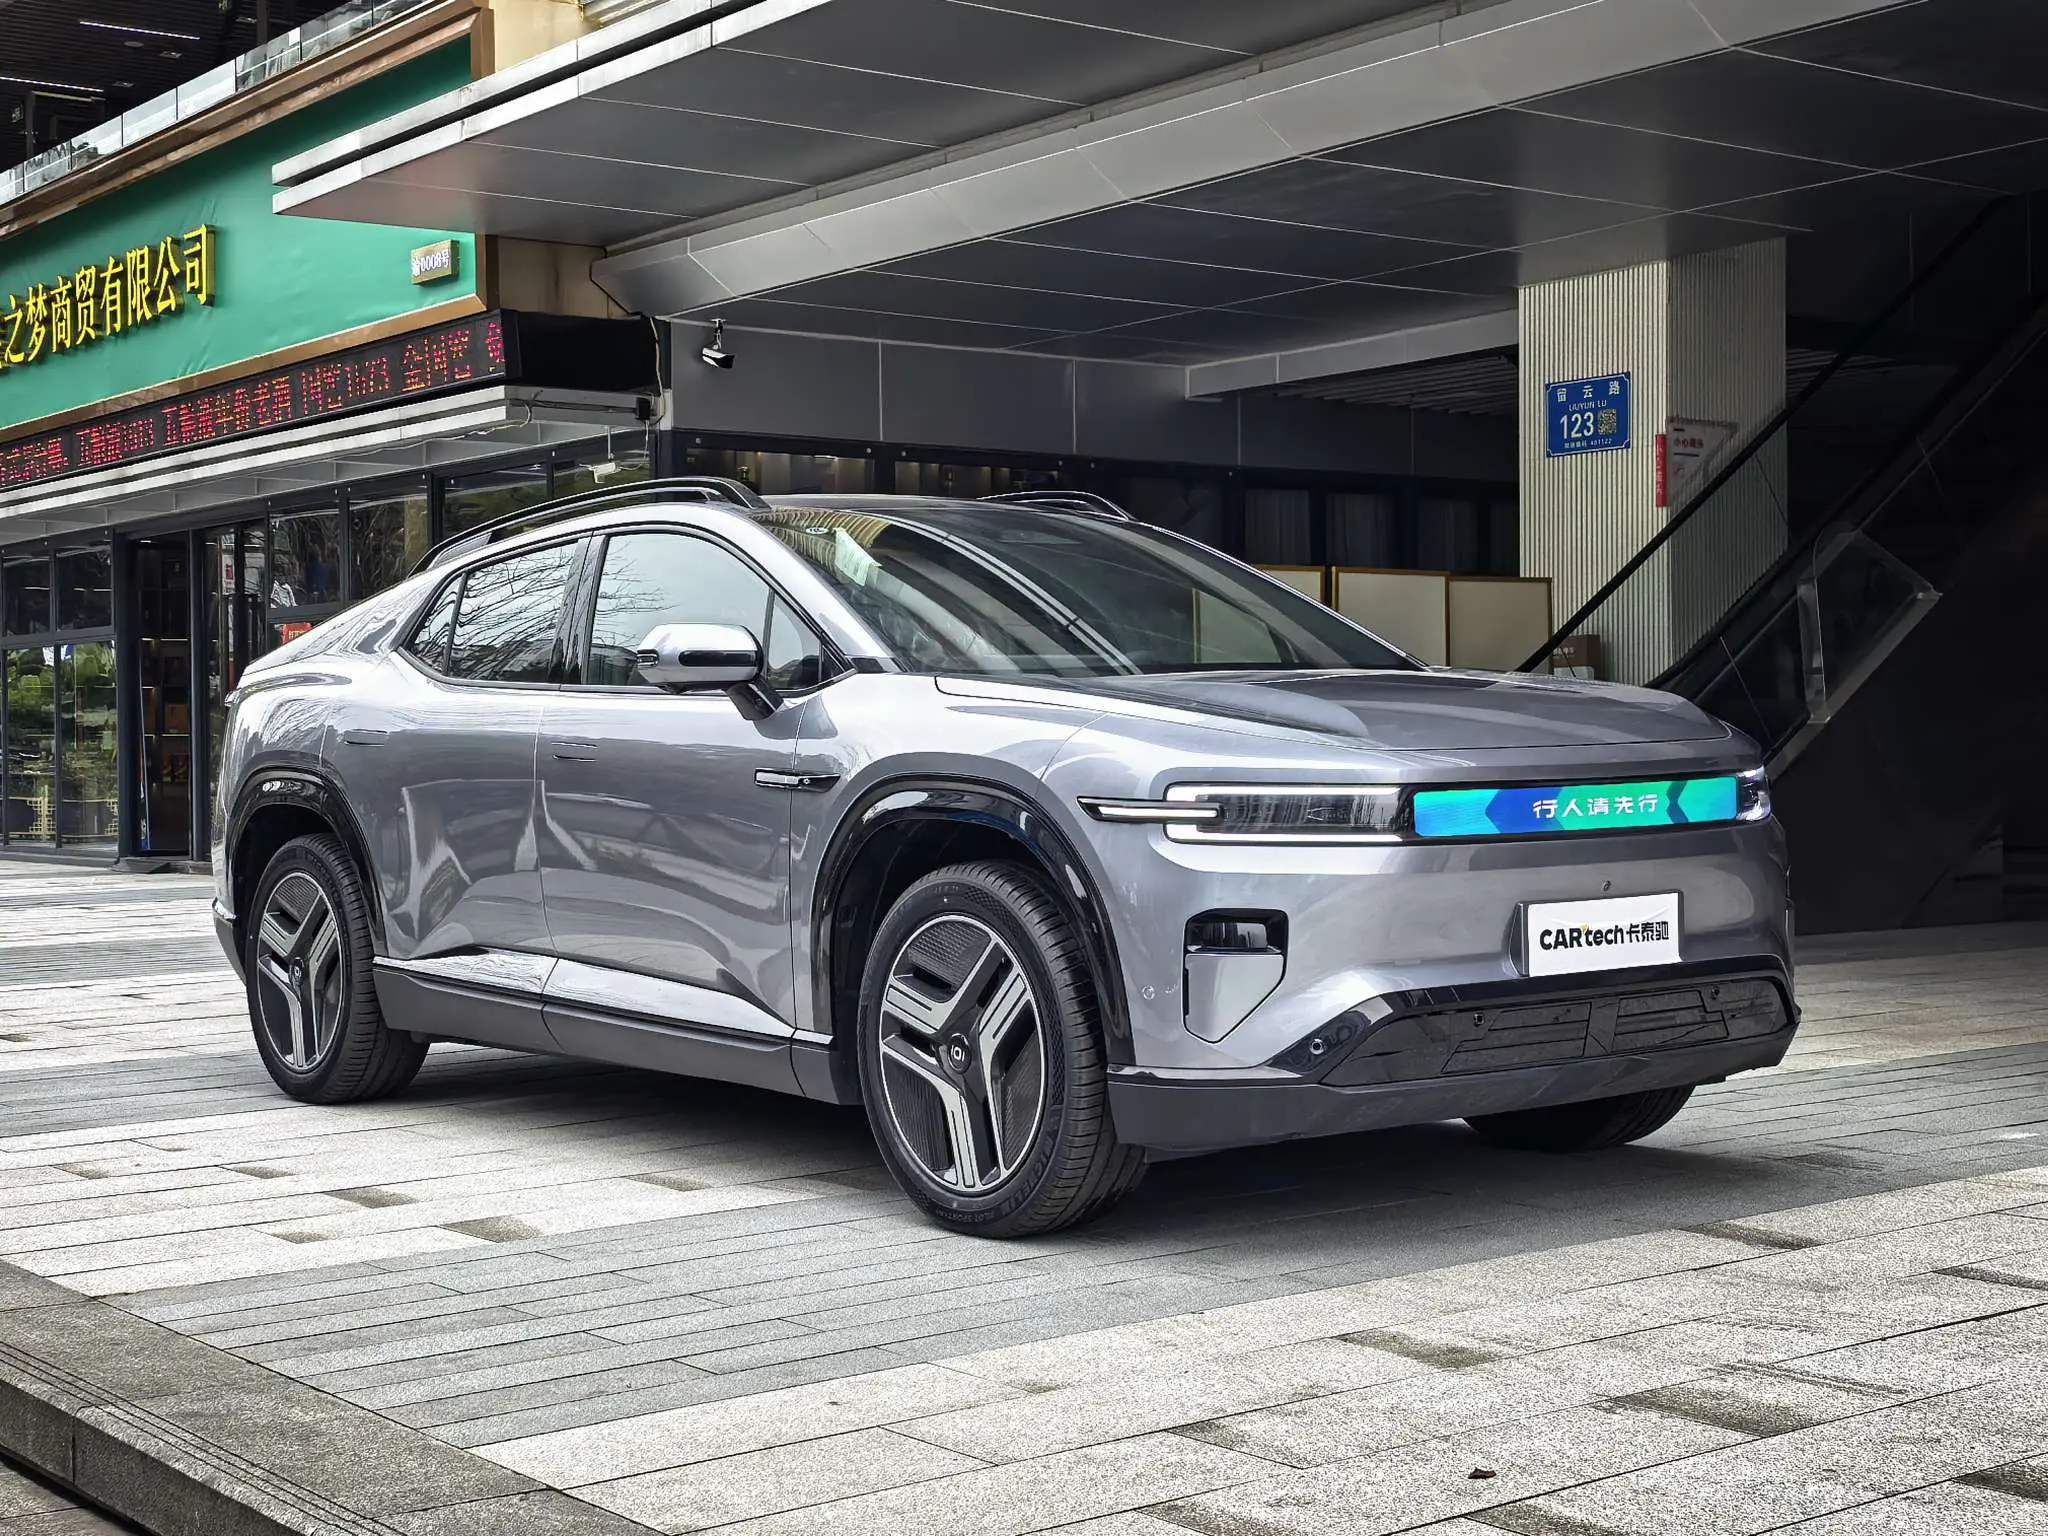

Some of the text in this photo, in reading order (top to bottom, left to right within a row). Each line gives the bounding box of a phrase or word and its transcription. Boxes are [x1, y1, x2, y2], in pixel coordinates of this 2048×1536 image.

[0, 223, 209, 370] 之梦商贸有限公司
[1557, 380, 1620, 402] 留云路
[1568, 400, 1607, 411] LIUYUN LU
[1560, 411, 1594, 439] 123
[1532, 794, 1658, 819] 行人请先行
[1539, 920, 1669, 951] CARtech 卡泰驰
